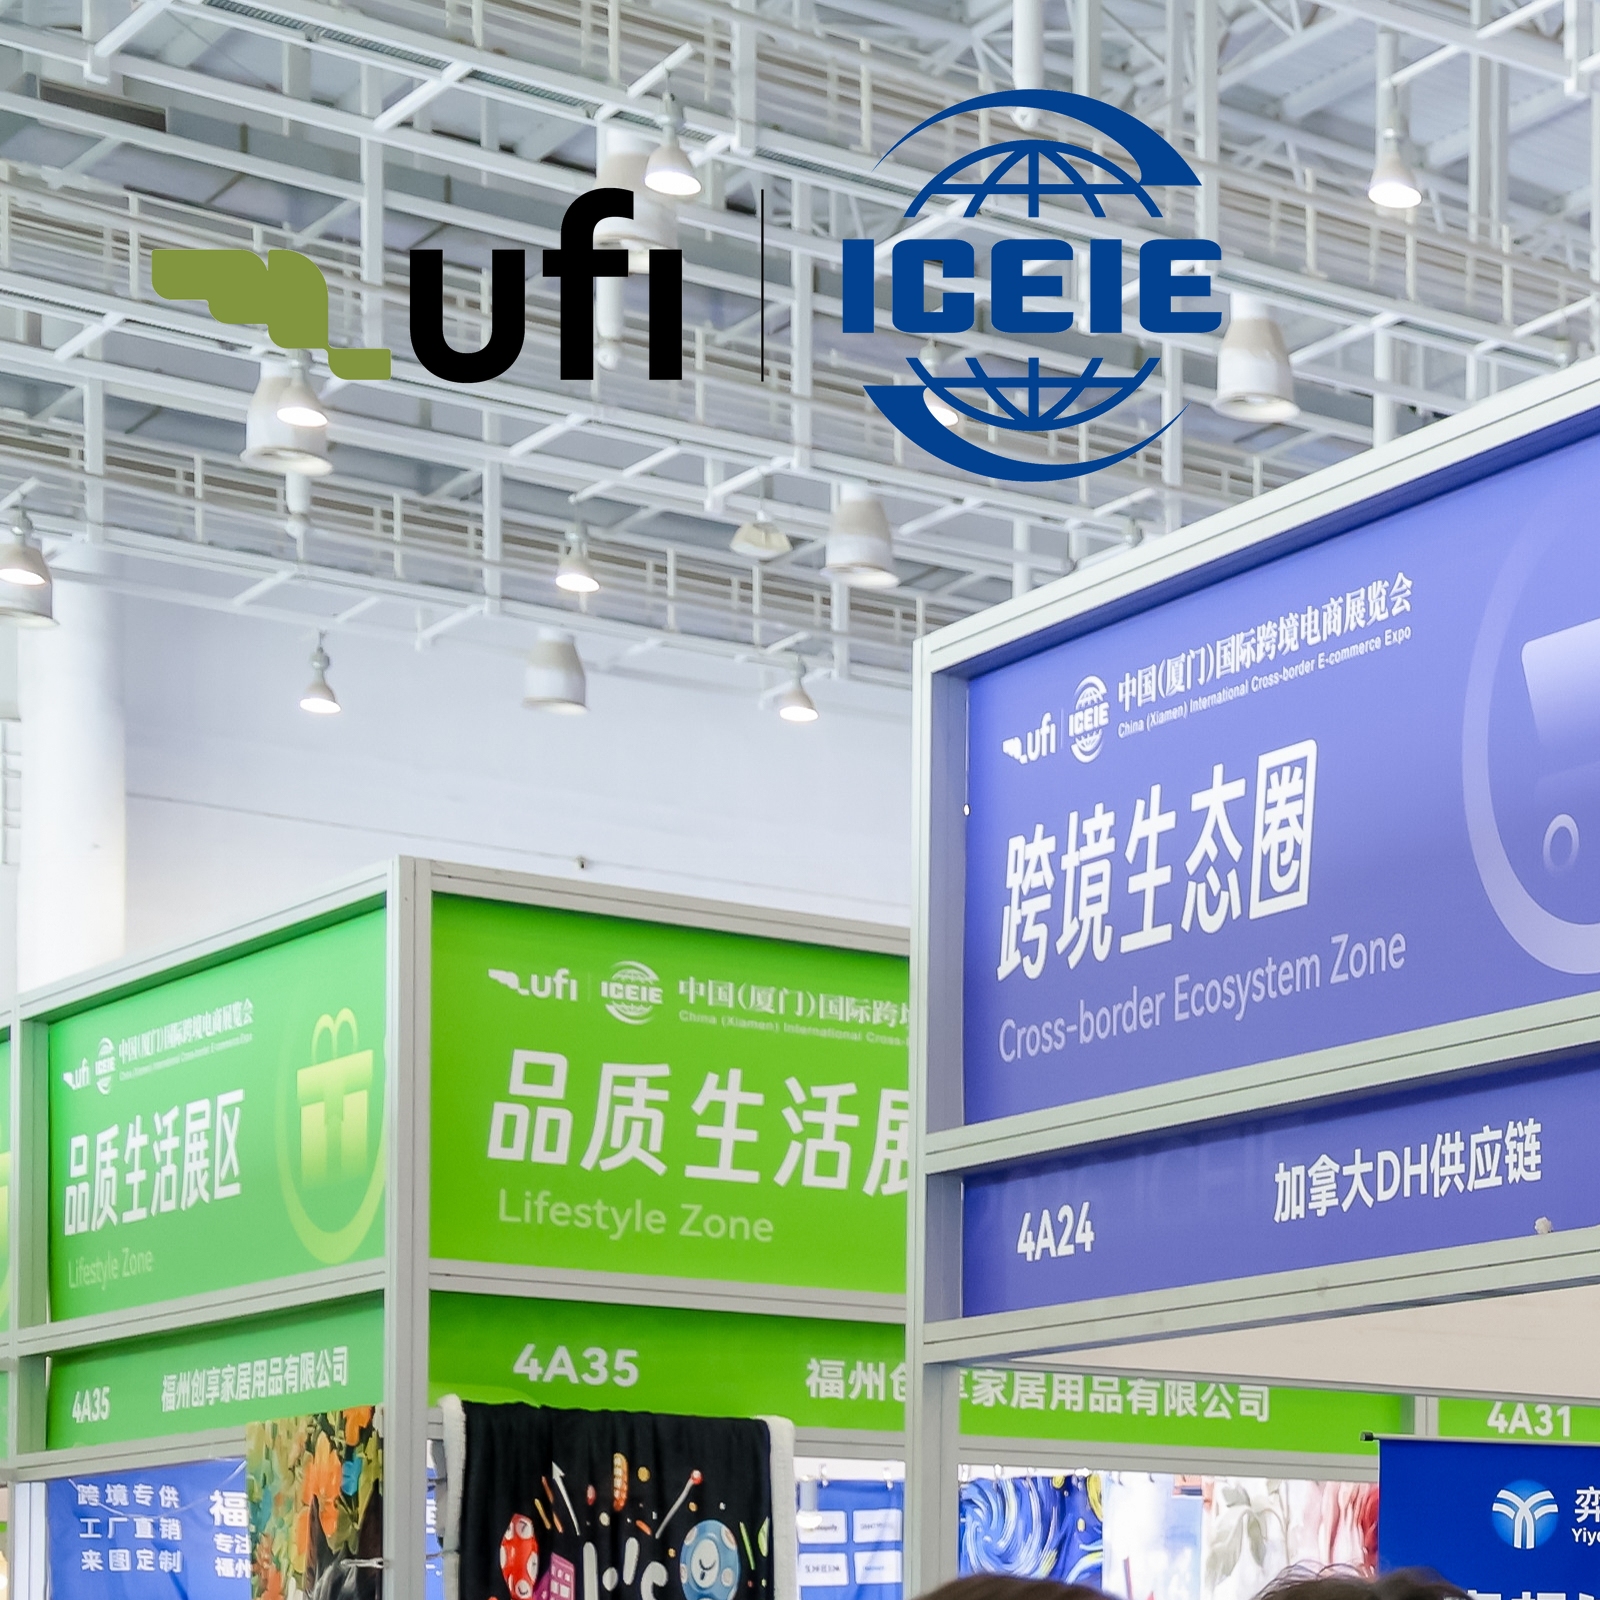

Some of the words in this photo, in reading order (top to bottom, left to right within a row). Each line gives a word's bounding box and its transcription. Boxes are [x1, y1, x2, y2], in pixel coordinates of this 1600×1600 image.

[1118, 717, 1144, 739] China
[1147, 705, 1188, 731] (Xiamen)
[1190, 681, 1248, 714] International
[1251, 658, 1315, 693] Cross-border
[1318, 636, 1381, 669] E-commerce
[1385, 625, 1411, 648] Expo
[1027, 712, 1056, 761] ufi
[1068, 701, 1110, 738] ICEIE
[997, 739, 1317, 983] 跨境生态圈
[531, 968, 578, 1001] ufi
[601, 980, 663, 1005] ICEIE
[999, 974, 1165, 1063] Cross-border
[1174, 950, 1321, 1024] Ecosystem
[1331, 931, 1407, 984] Zone
[679, 1009, 718, 1027] China
[64, 1089, 244, 1236] 品质生活展区
[1273, 1118, 1544, 1224] 加拿大DH供应链
[499, 1188, 667, 1240] Lifestyle
[679, 1203, 773, 1242] Zone
[1016, 1202, 1095, 1262] 4A24
[69, 1253, 119, 1290] Lifestyle
[121, 1248, 154, 1278] Zone
[161, 1346, 348, 1412] 福州创享家居用品有限公司
[512, 1342, 640, 1388] 4A35
[72, 1386, 110, 1424] 4A35
[959, 1368, 1270, 1422] 家居用品有限公司
[1486, 1401, 1571, 1438] 4A31
[77, 1484, 180, 1509] 跨境专供
[79, 1517, 182, 1541] 工厂直销
[81, 1549, 182, 1574] 来图定制
